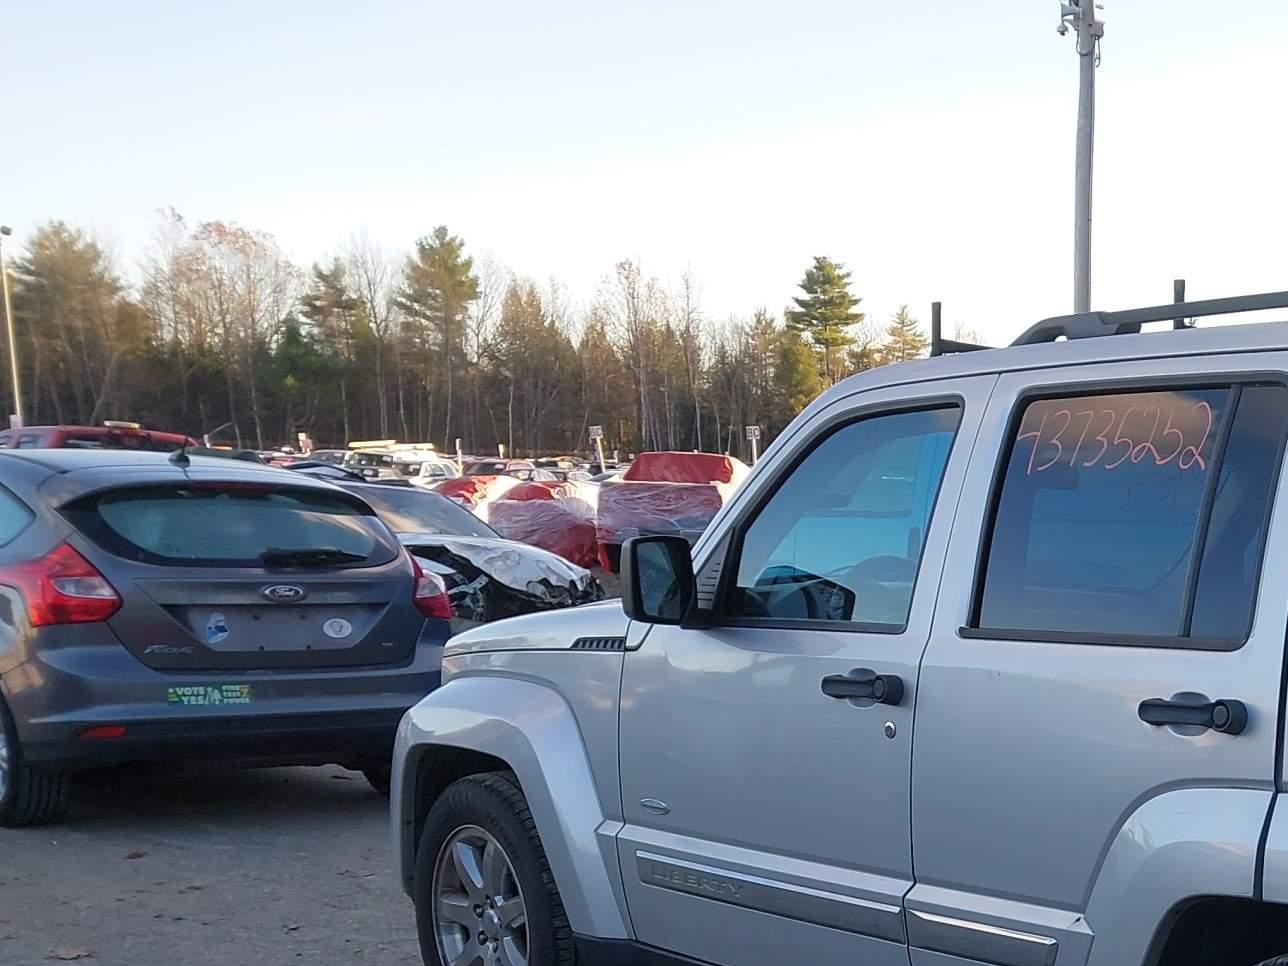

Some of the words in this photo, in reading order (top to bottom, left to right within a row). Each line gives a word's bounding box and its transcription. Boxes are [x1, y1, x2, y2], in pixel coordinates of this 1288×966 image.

[1017, 400, 1213, 475] 43735252
[175, 686, 205, 696] VOTE
[181, 695, 205, 705] YES
[651, 862, 742, 898] LIBERTY
